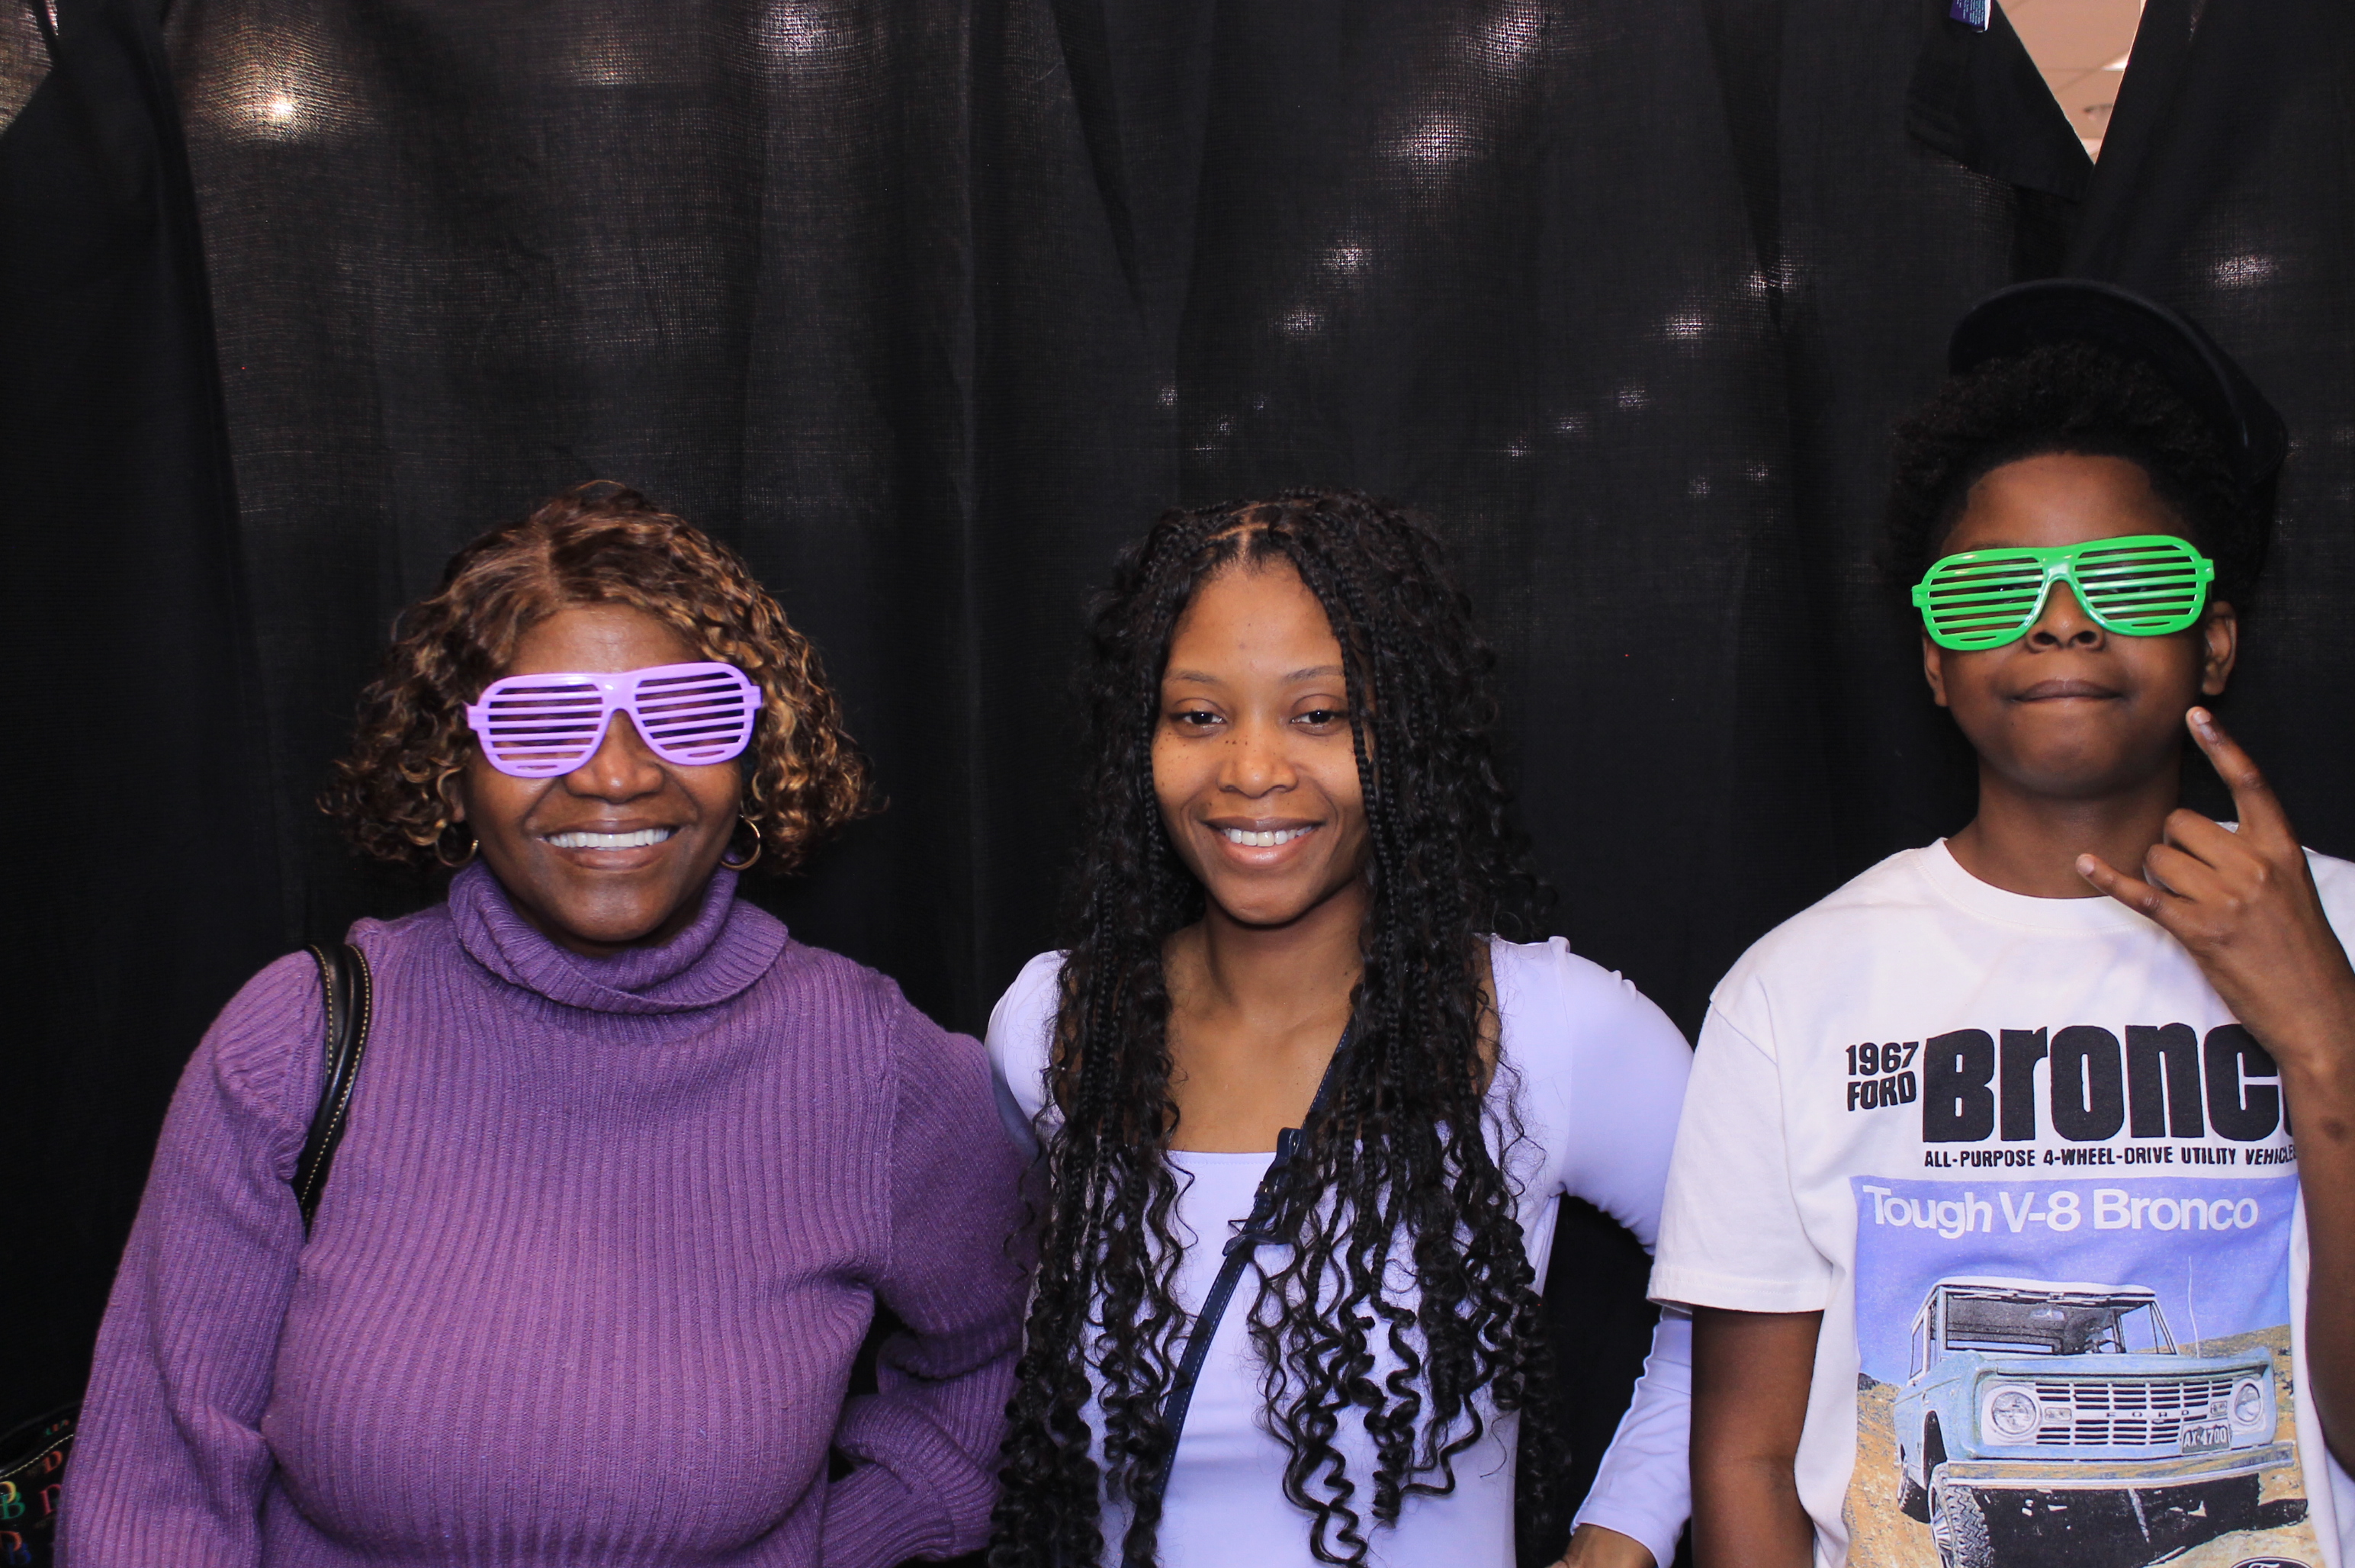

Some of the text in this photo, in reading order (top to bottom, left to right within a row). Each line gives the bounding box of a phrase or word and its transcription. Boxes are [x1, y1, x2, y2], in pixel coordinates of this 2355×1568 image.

[1846, 1041, 1919, 1076] 1967
[1847, 1071, 1916, 1111] FORD
[1923, 1023, 2293, 1142] Bronc
[1924, 1150, 2035, 1167] ALL-PURPOSE
[2043, 1147, 2173, 1165] 4-WHEEL-DRIVE
[2181, 1146, 2236, 1165] UTILITY
[1862, 1185, 2259, 1239] Tough V-8 Bronco
[2106, 1409, 2190, 1419] FORD
